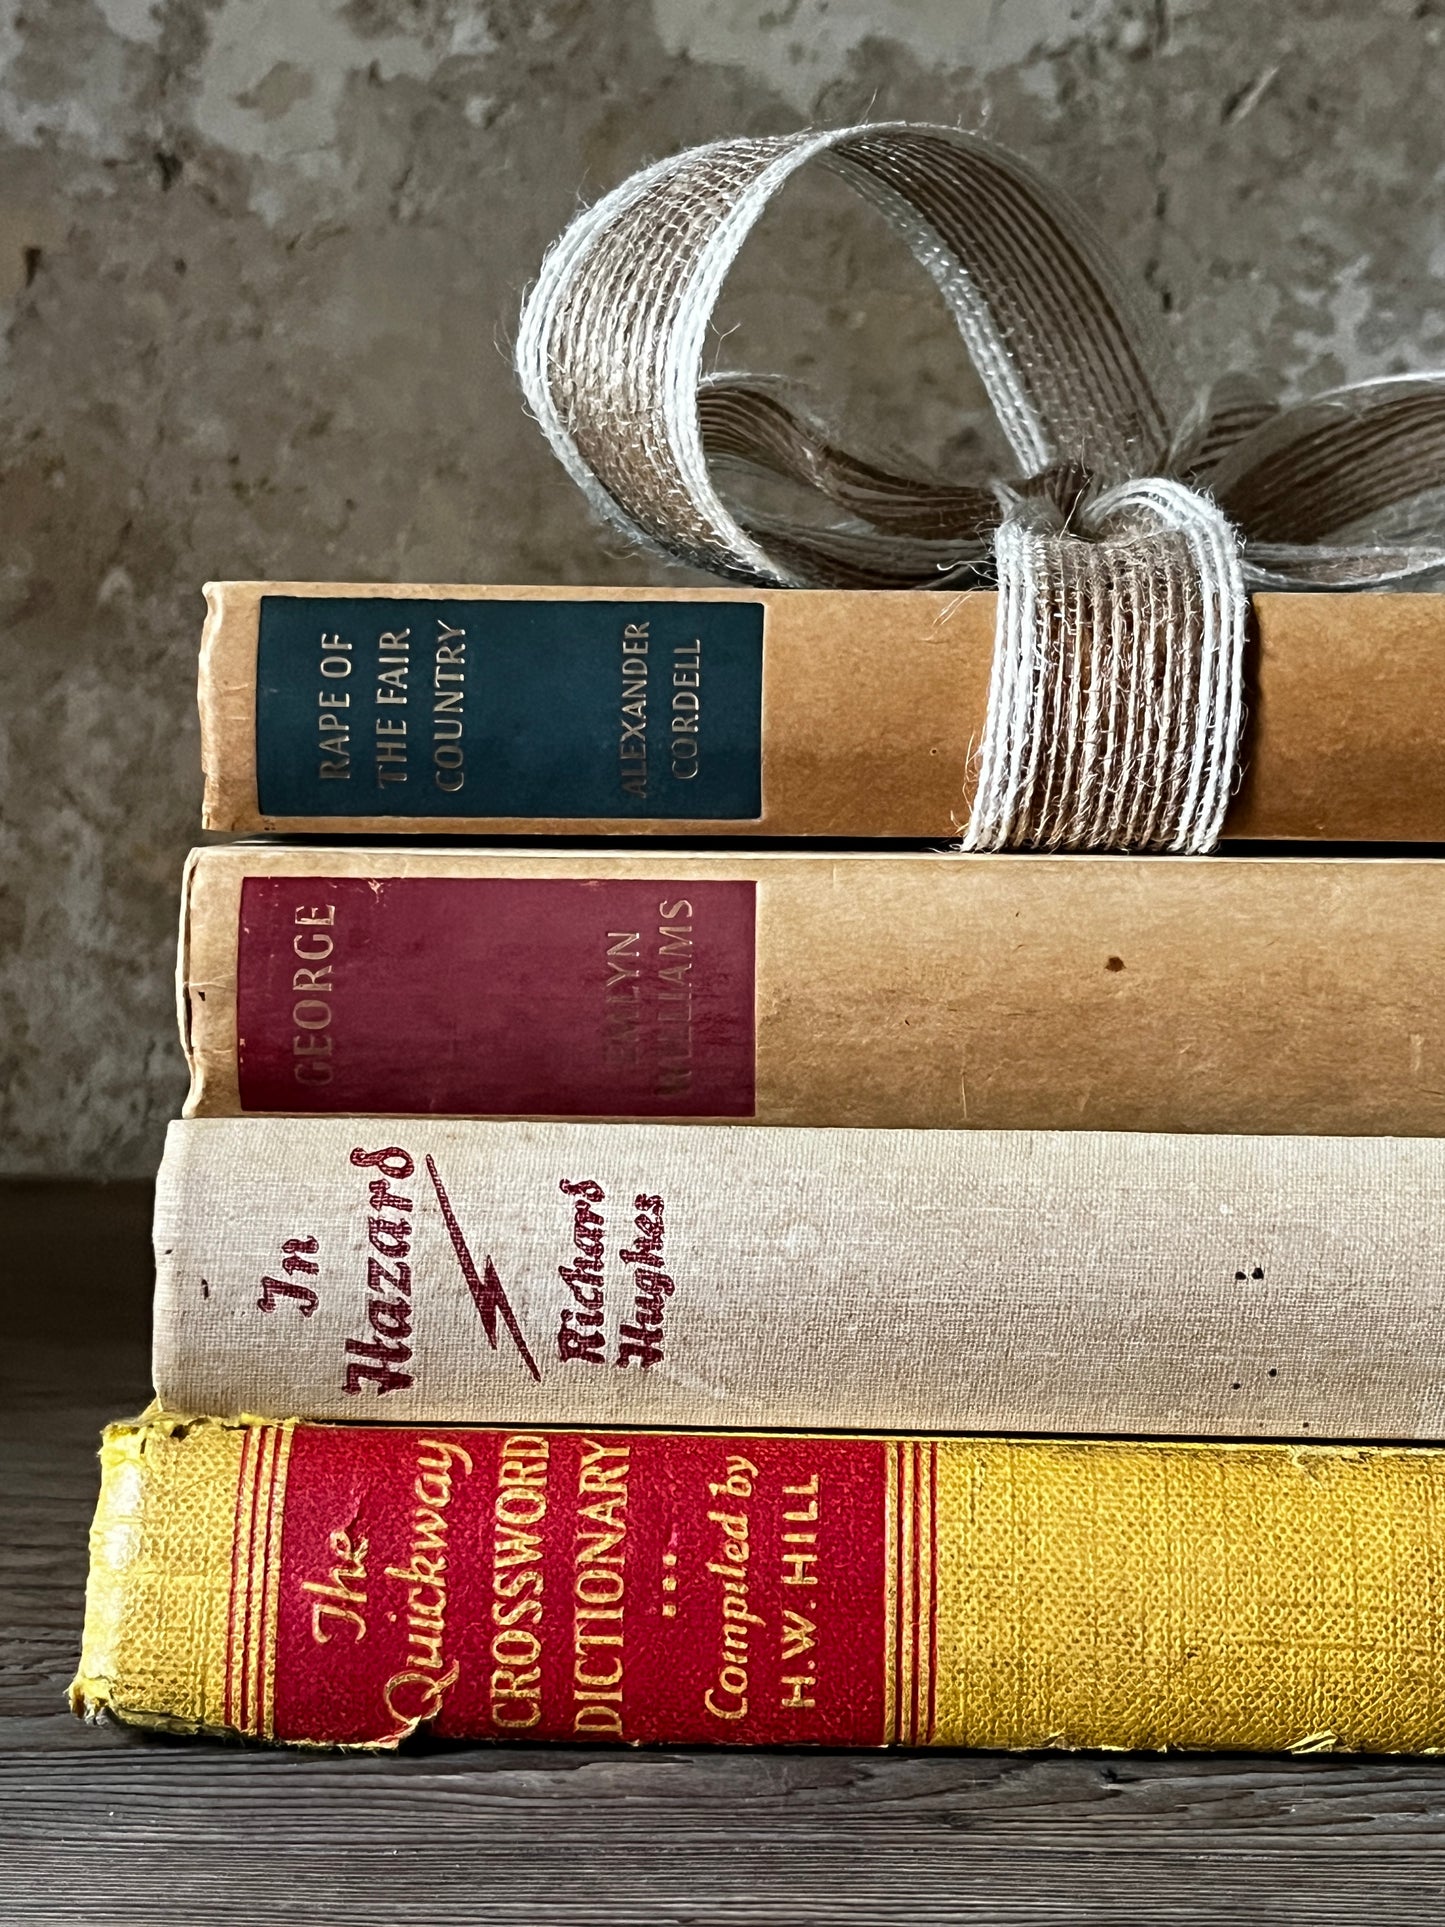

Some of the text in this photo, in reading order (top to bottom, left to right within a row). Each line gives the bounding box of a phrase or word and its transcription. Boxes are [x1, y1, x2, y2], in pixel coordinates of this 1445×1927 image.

[319, 632, 353, 780] RAPE OF
[376, 628, 411, 789] THE FAIR
[433, 619, 466, 792] COUNTRY
[621, 621, 650, 799] ALEXANDER
[671, 639, 700, 779] CORDELL
[292, 904, 336, 1087] GEORGE
[658, 899, 693, 1098] WILLIAMS
[257, 1235, 319, 1318] In
[342, 1146, 415, 1395] Hazard
[557, 1178, 606, 1364] Richard
[615, 1193, 676, 1369] Hughes
[302, 1527, 370, 1645] The
[383, 1437, 473, 1726] Quickway
[491, 1434, 550, 1729] CROSSWORD
[574, 1438, 630, 1735] DICTIONARY
[705, 1455, 766, 1720] Compiled by
[782, 1474, 819, 1585] HILL
